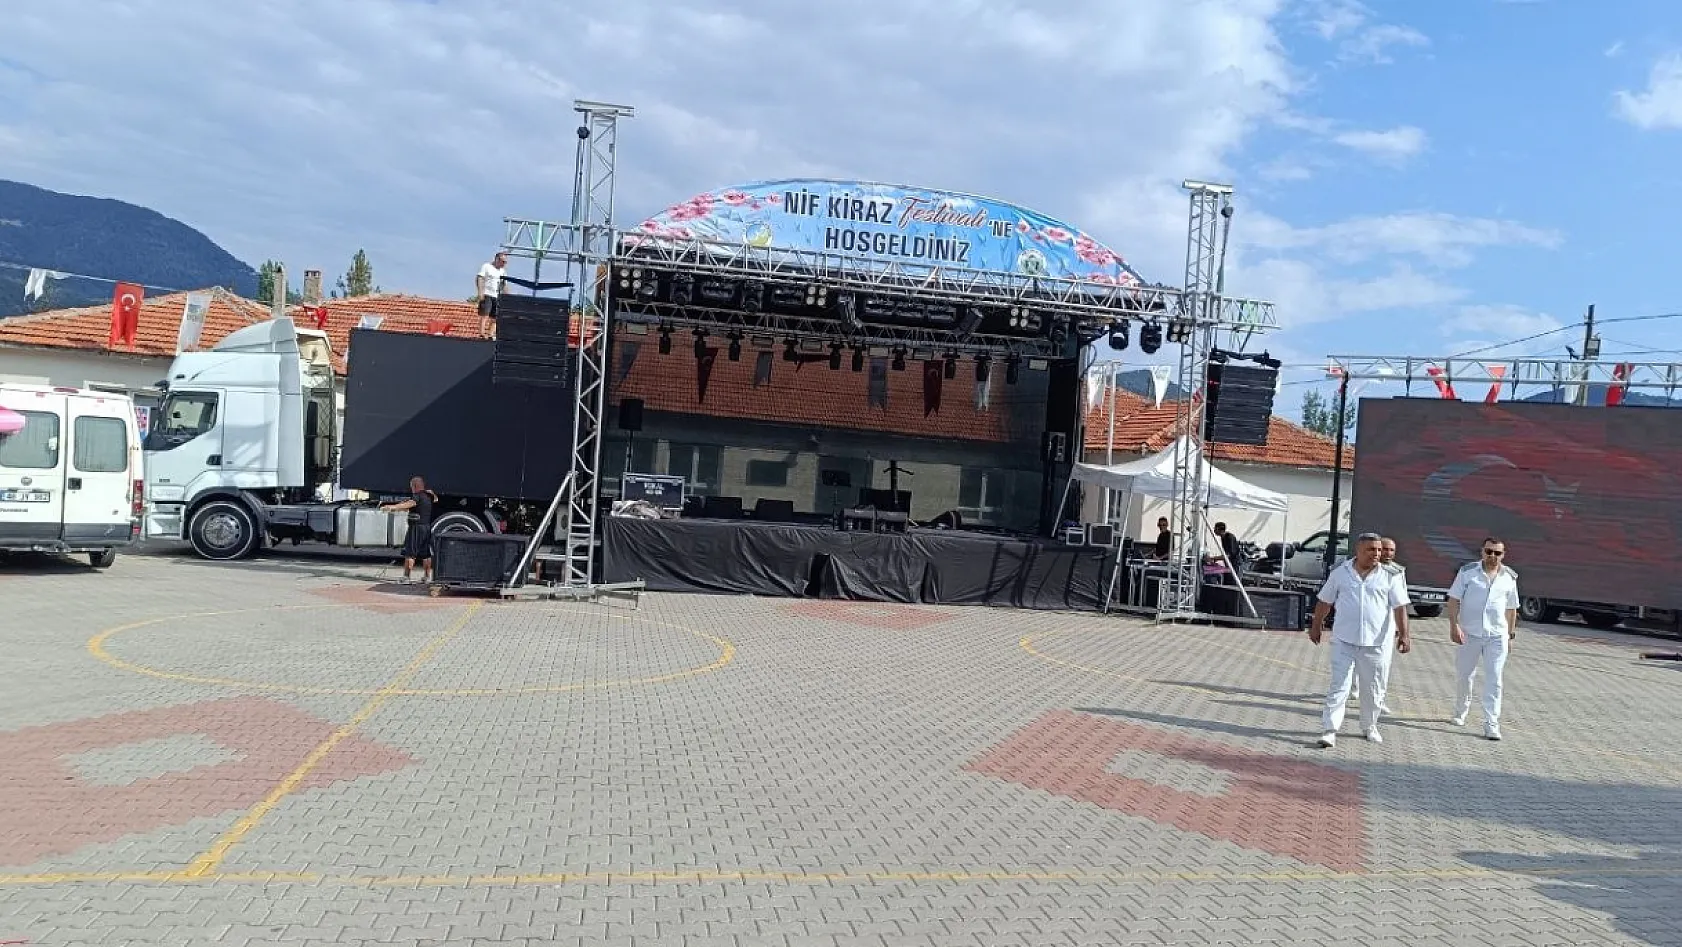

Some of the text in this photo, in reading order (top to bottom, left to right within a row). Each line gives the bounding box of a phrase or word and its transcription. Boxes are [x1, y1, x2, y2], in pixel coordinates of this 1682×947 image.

[784, 188, 820, 216] NİF
[827, 192, 893, 224] KİRAZ
[898, 196, 987, 229] Festivali
[825, 226, 970, 263] HOŞGELDİNİZ
